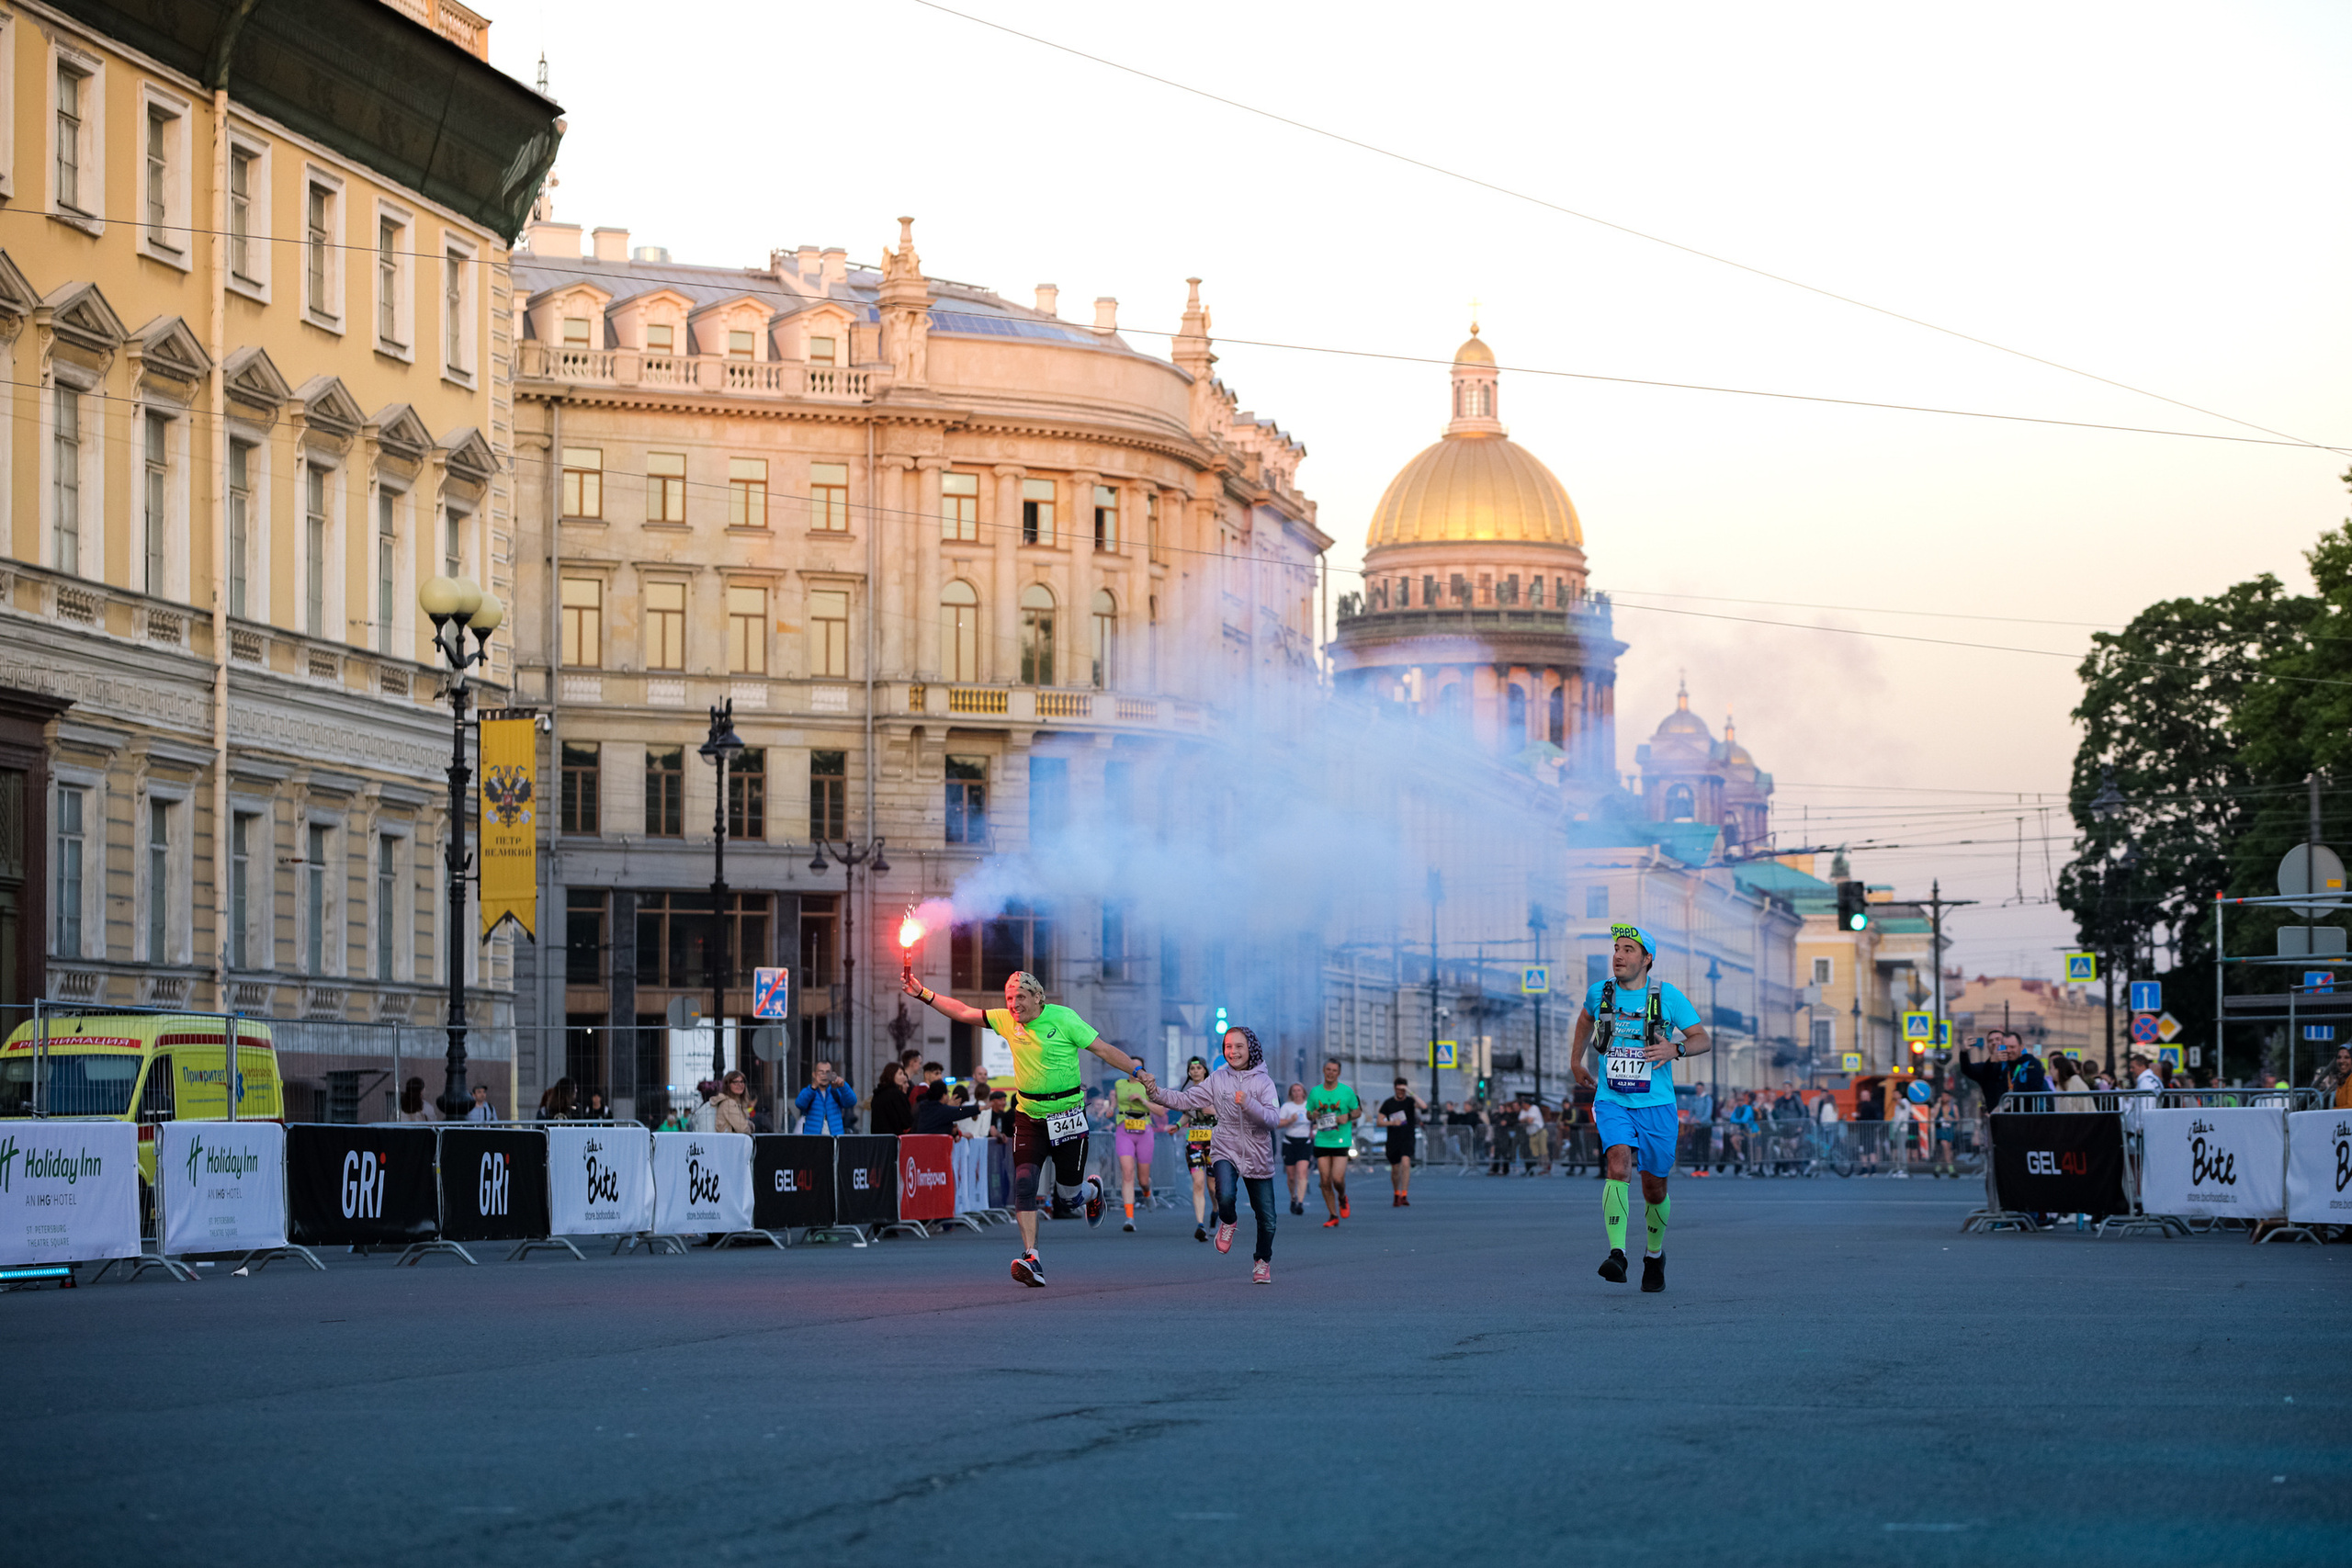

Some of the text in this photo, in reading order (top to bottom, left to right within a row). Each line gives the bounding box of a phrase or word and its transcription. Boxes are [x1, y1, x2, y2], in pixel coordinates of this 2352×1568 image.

[485, 846, 531, 857] ВЕЛИКИЙ
[1611, 1059, 1645, 1074] 4117
[183, 1066, 225, 1086] Приоритет
[1054, 1116, 1083, 1134] 3414
[2192, 1118, 2208, 1134] take
[587, 1137, 598, 1153] take
[689, 1142, 701, 1156] take
[25, 1146, 102, 1185] Holiday Inn
[207, 1145, 258, 1179] Holiday Inn
[2192, 1136, 2237, 1186] Bite
[342, 1150, 387, 1219] GRi
[479, 1152, 510, 1216] GRi
[586, 1156, 619, 1205] Bite
[689, 1159, 720, 1205] Bite
[26, 1195, 36, 1206] AN
[53, 1194, 77, 1205] HOTEL
[208, 1189, 215, 1199] AN
[226, 1188, 243, 1199] HOTEL
[35, 1224, 67, 1234] PETERSBURG
[28, 1237, 70, 1248] THEATRE SQUARE
